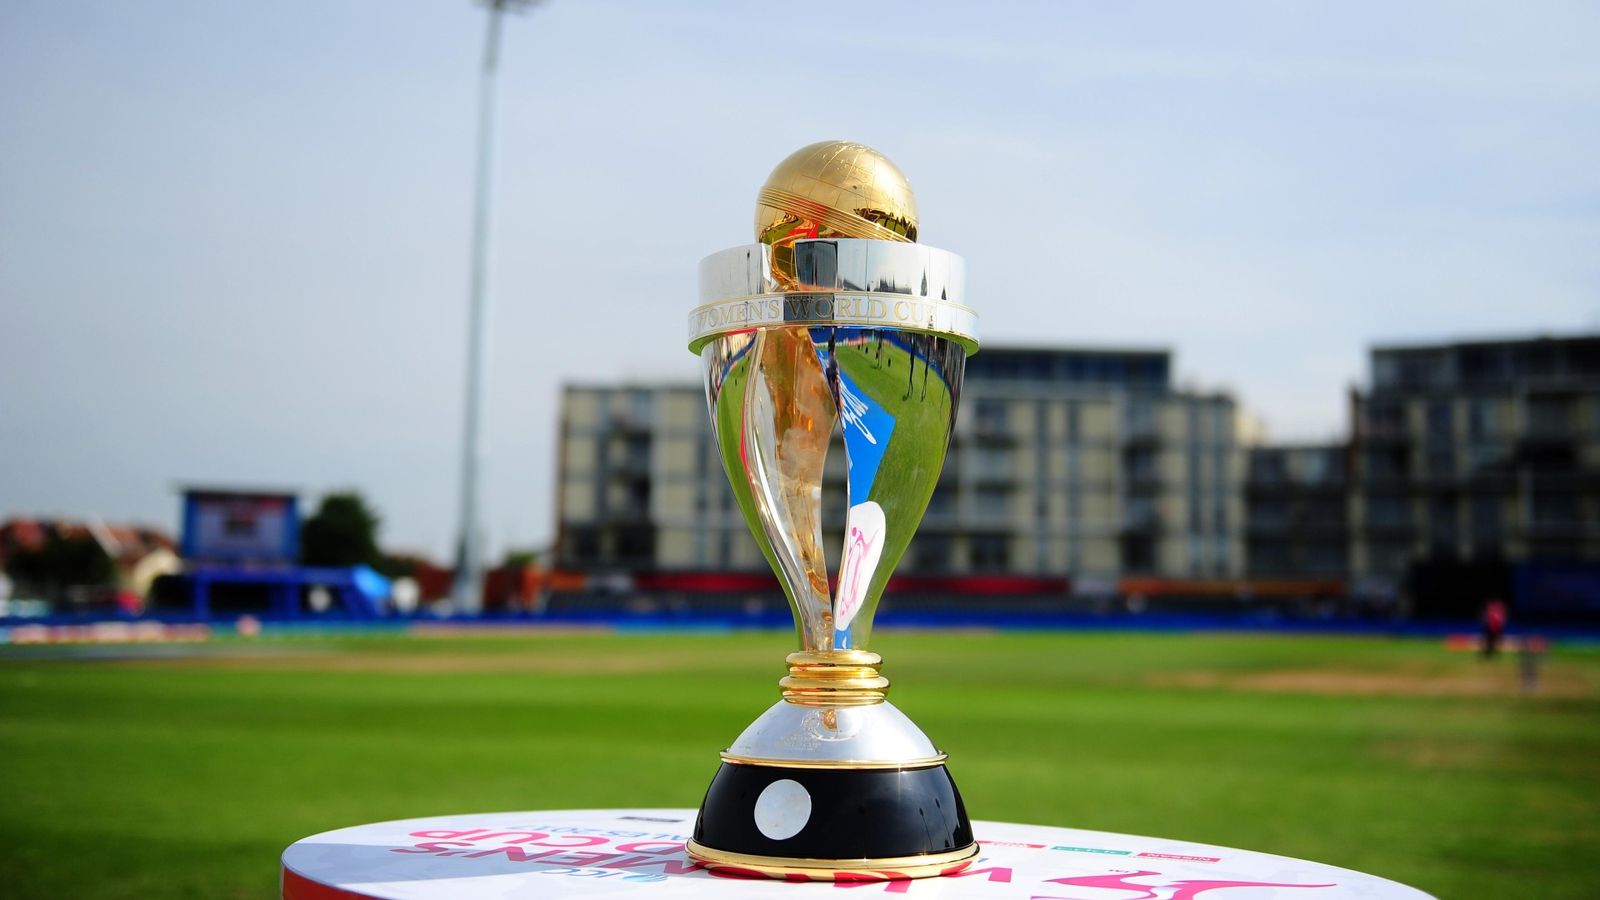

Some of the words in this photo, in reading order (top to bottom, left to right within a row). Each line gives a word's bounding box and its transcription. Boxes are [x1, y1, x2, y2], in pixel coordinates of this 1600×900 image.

[695, 299, 780, 329] WOMEN'S
[785, 296, 887, 320] WORLD
[893, 301, 937, 324] CUP
[409, 829, 610, 848] CUP
[540, 868, 624, 879] ICC
